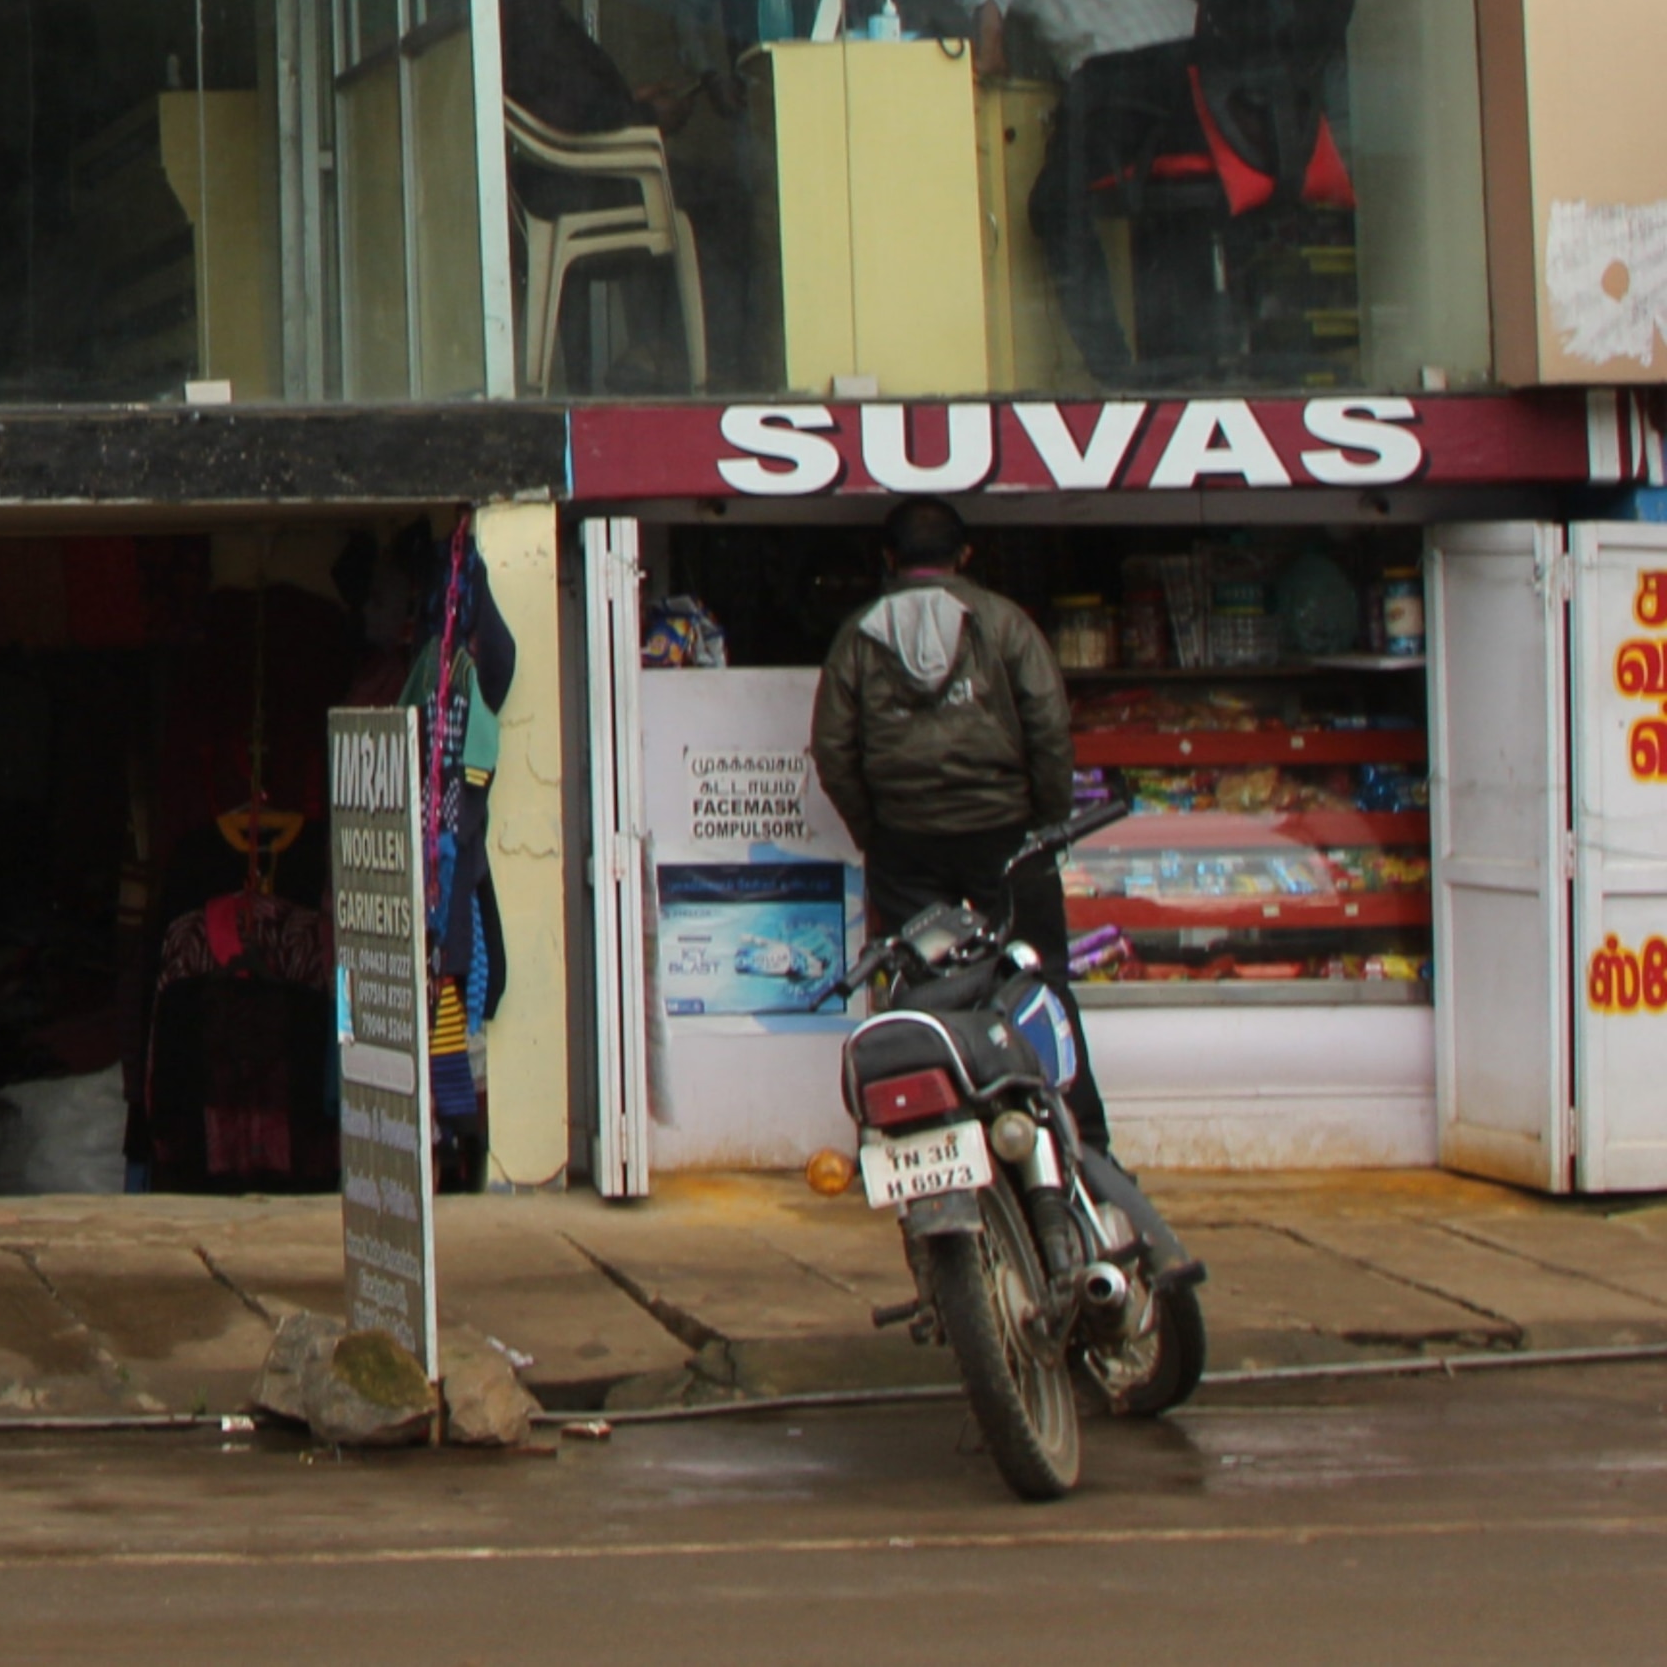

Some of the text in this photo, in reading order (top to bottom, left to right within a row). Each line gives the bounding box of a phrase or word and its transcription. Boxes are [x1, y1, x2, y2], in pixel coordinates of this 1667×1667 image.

[717, 396, 1426, 496] SUVAS
[332, 731, 406, 815] IMRAN
[692, 798, 802, 817] FACEMASK
[692, 820, 805, 839] COMPULSORY
[340, 826, 406, 873] WOOLLEN
[337, 889, 411, 939] GARMENTS
[890, 1150, 920, 1172] TN
[911, 1166, 974, 1194] 6973
